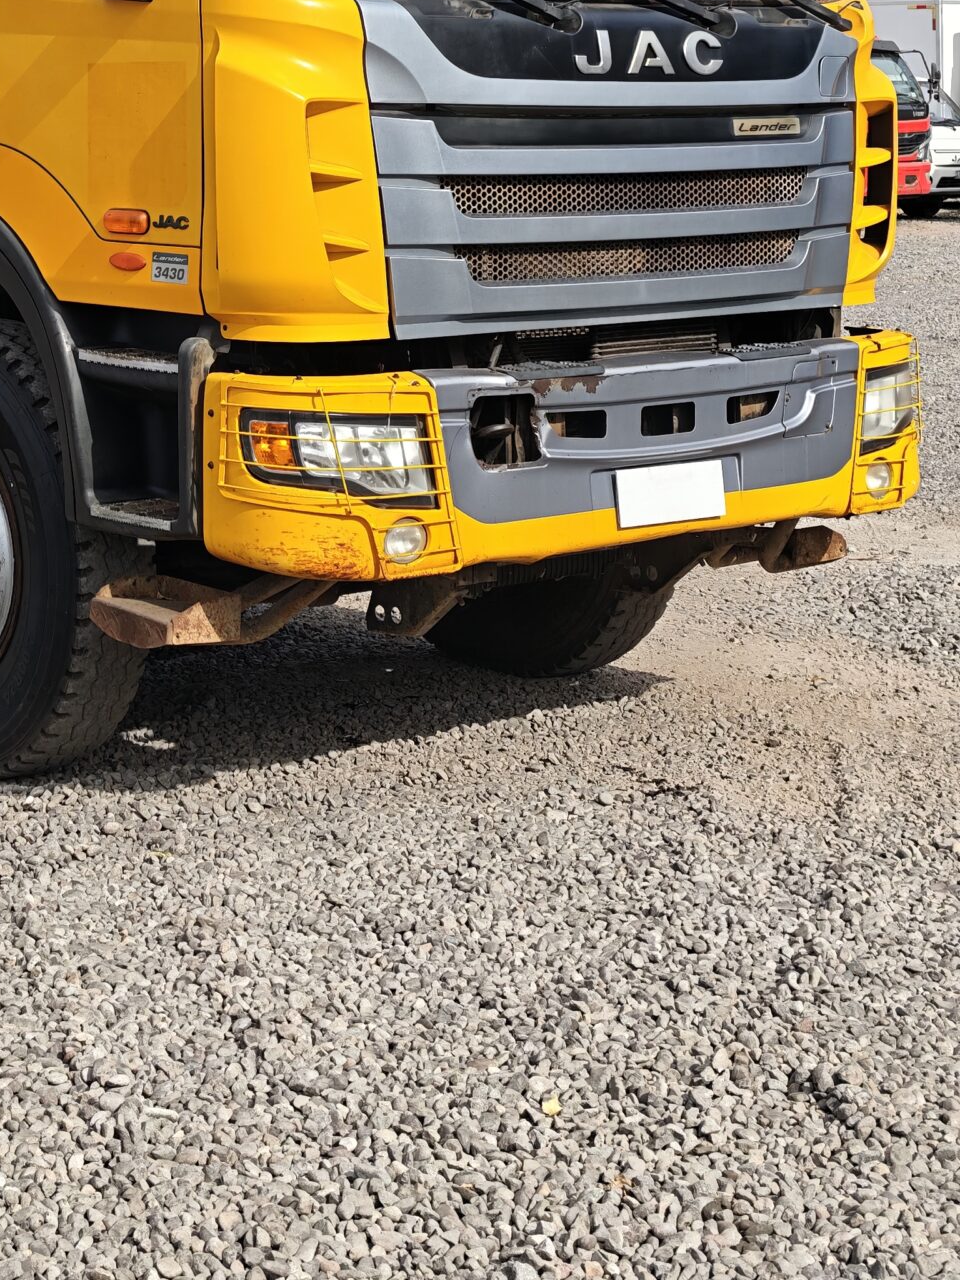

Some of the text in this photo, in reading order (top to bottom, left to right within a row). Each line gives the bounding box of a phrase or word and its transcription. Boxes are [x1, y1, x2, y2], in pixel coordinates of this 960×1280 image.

[574, 29, 724, 75] JAC
[738, 122, 797, 133] Lander
[152, 215, 189, 229] JAC
[154, 267, 184, 280] 3430
